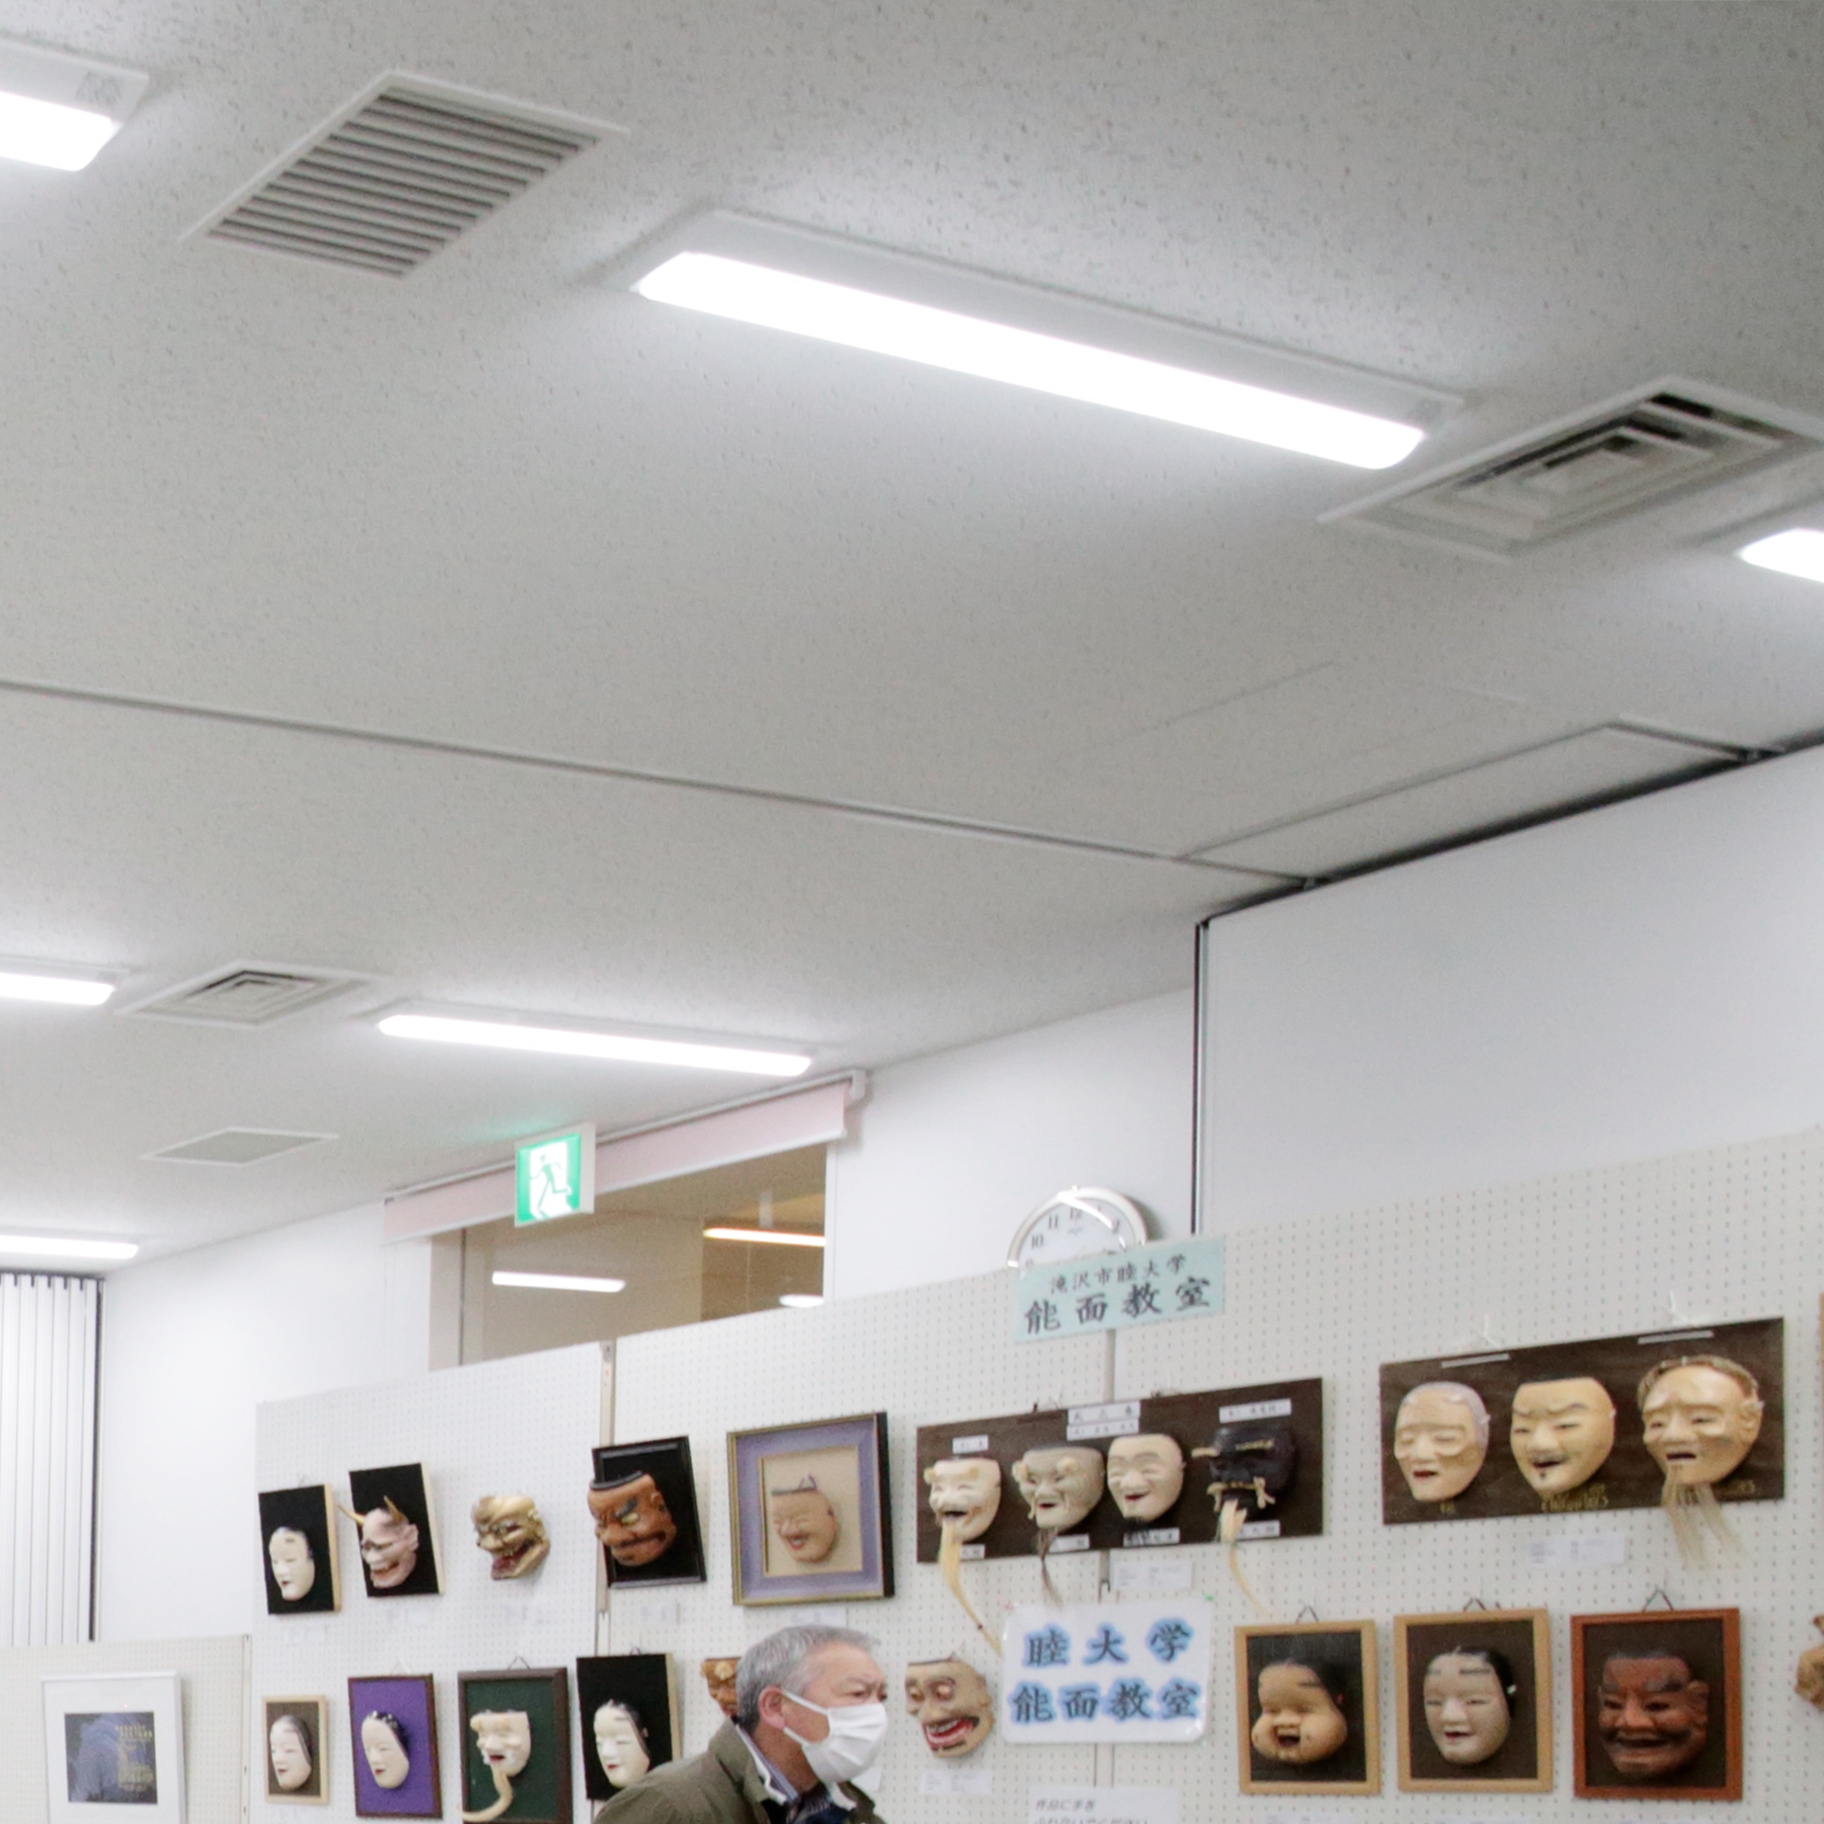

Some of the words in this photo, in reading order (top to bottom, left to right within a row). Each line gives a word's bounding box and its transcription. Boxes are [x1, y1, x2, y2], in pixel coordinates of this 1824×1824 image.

[1032, 1234, 1044, 1249] 10
[1048, 1213, 1058, 1230] 11
[1050, 1253, 1186, 1295] 滝沢市睦大学
[1024, 1276, 1211, 1334] 能面教室
[1024, 1620, 1193, 1667] 睦大学
[1010, 1680, 1199, 1723] 能面教室
